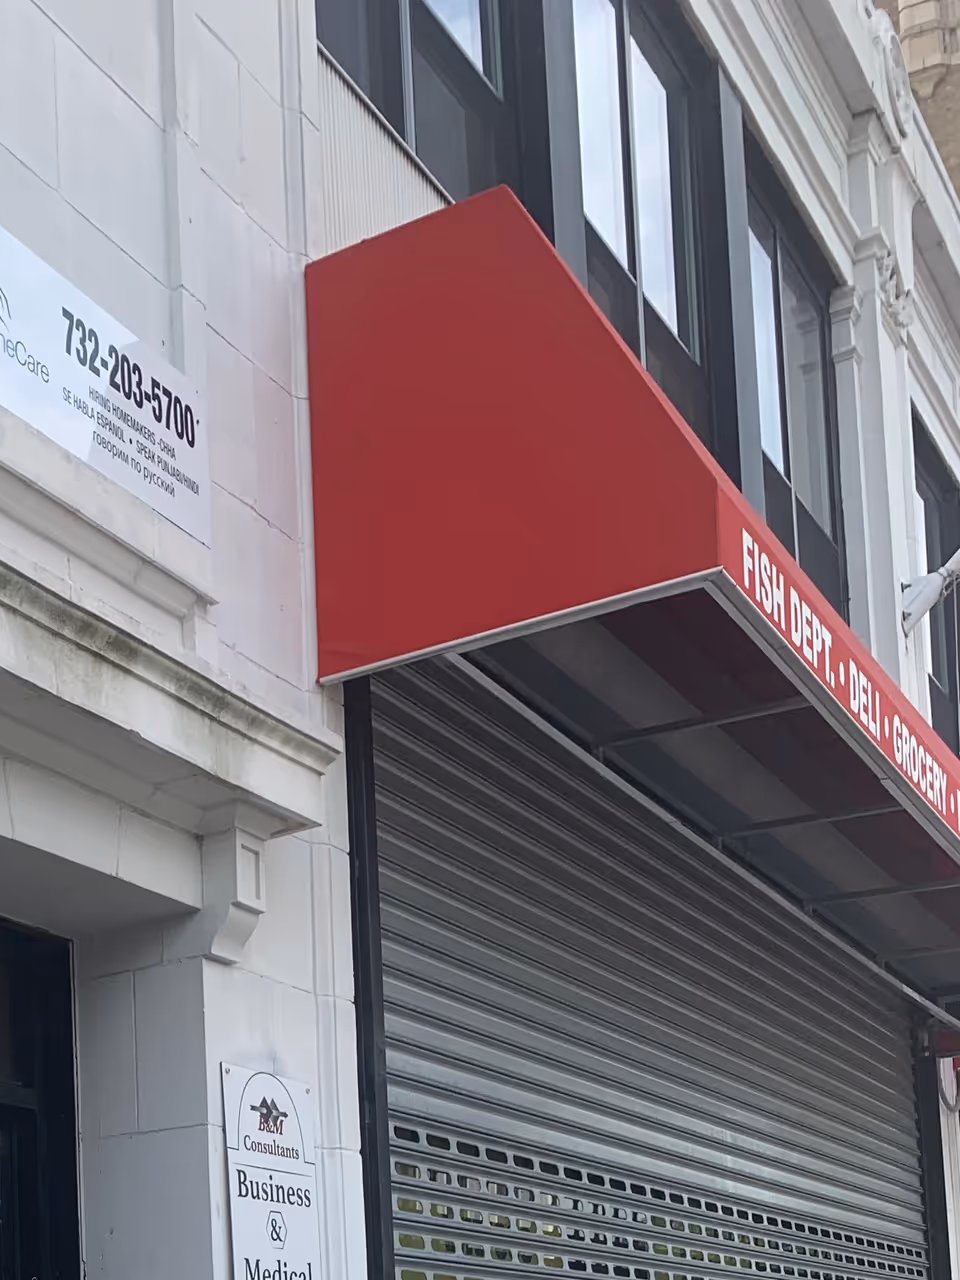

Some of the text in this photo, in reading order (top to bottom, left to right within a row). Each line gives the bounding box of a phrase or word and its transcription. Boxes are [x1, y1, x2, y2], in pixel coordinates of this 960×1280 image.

[62, 306, 195, 448] 732-203-5700
[62, 387, 72, 405] SE
[73, 394, 95, 420] HABLA
[136, 440, 156, 464] SPEAK
[89, 386, 111, 411] HIRING
[112, 402, 156, 445] HOMEMAKERS
[131, 458, 142, 474] по
[143, 467, 175, 498] русский
[742, 527, 947, 815] FISH DEPT. DELI GROCERY
[258, 1115, 284, 1136] B&M
[244, 1134, 300, 1160] Consultants
[236, 1169, 312, 1208] Business
[271, 1218, 283, 1243] &
